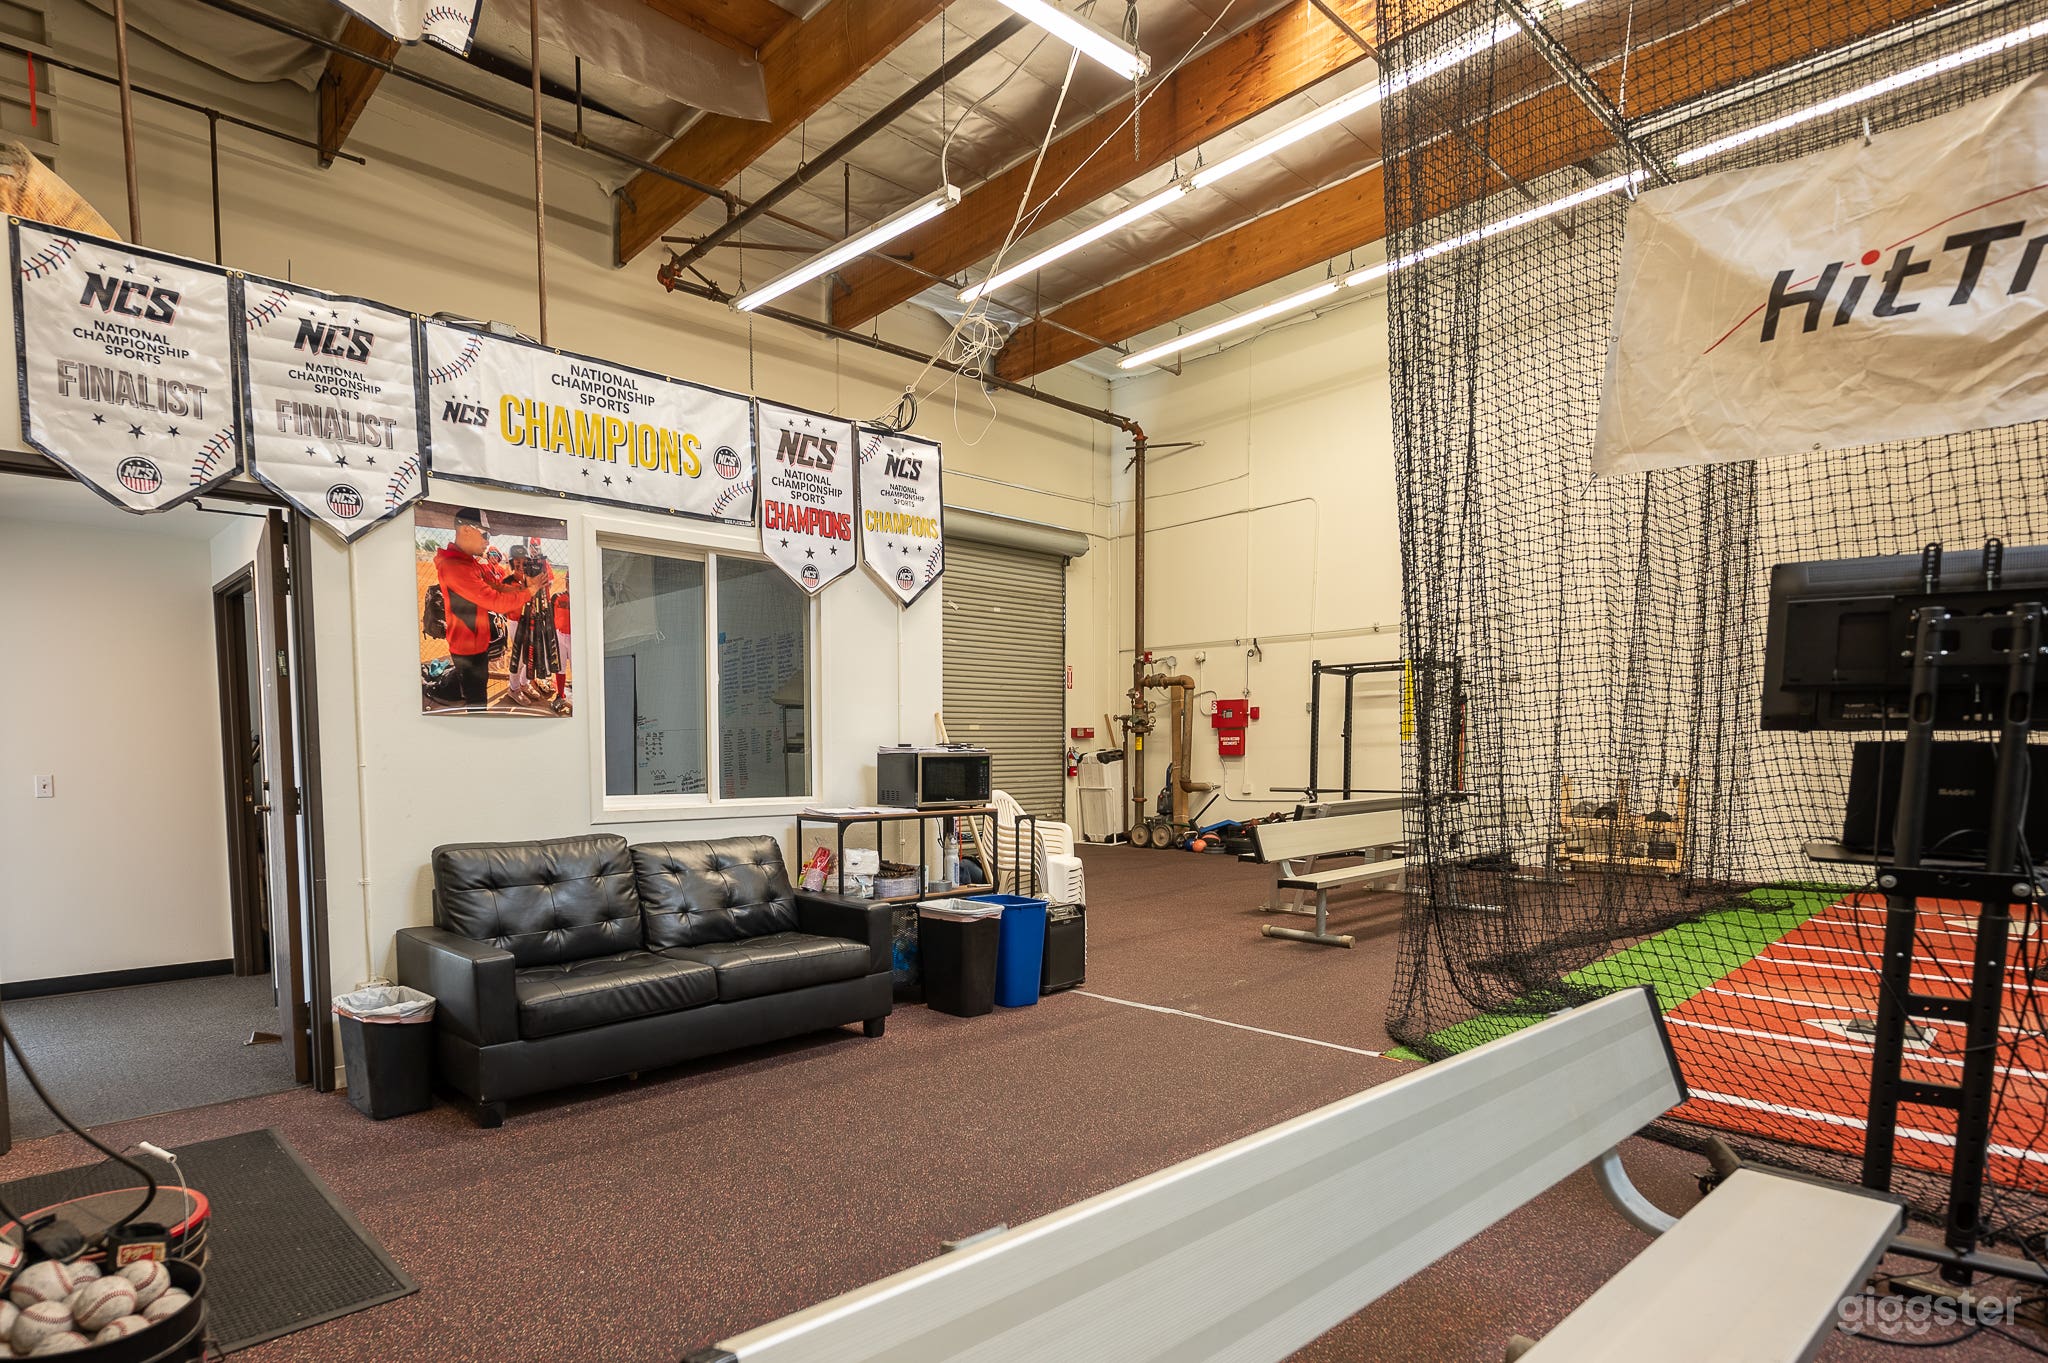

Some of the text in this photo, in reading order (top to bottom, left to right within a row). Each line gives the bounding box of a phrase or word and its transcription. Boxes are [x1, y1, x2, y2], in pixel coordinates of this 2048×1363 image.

[79, 271, 182, 326] NCS
[72, 327, 190, 360] CHAMPIONSHIP
[93, 319, 171, 346] NATIONAL
[293, 318, 376, 364] NCS
[105, 344, 162, 365] SPORTS
[288, 369, 382, 395] CHAMPIONSHIP
[304, 361, 367, 383] NATIONAL
[570, 364, 639, 391] NATIONAL
[57, 359, 208, 421] FINALIST
[314, 383, 360, 400] SPORTS
[551, 373, 656, 407] CHAMPIONSHIP
[442, 399, 490, 427] NCS
[579, 393, 631, 414] SPORTS
[275, 399, 397, 450] FINALIST
[499, 394, 702, 479] CHAMPIONS
[716, 453, 738, 467] NCS
[776, 428, 838, 472] NCS
[122, 464, 156, 479] NCS
[784, 468, 832, 486] NATIONAL
[884, 452, 923, 482] NCS
[329, 493, 359, 506] NCS
[771, 477, 843, 498] CHAMPIONSHIP
[790, 490, 826, 505] SPORTS
[880, 489, 925, 502] CHAMPIONSHIP
[889, 483, 918, 495] NATIONAL
[893, 498, 915, 508] SPORTS
[765, 499, 851, 542] CHAMPIONS
[865, 509, 939, 540] CHAMPIONS
